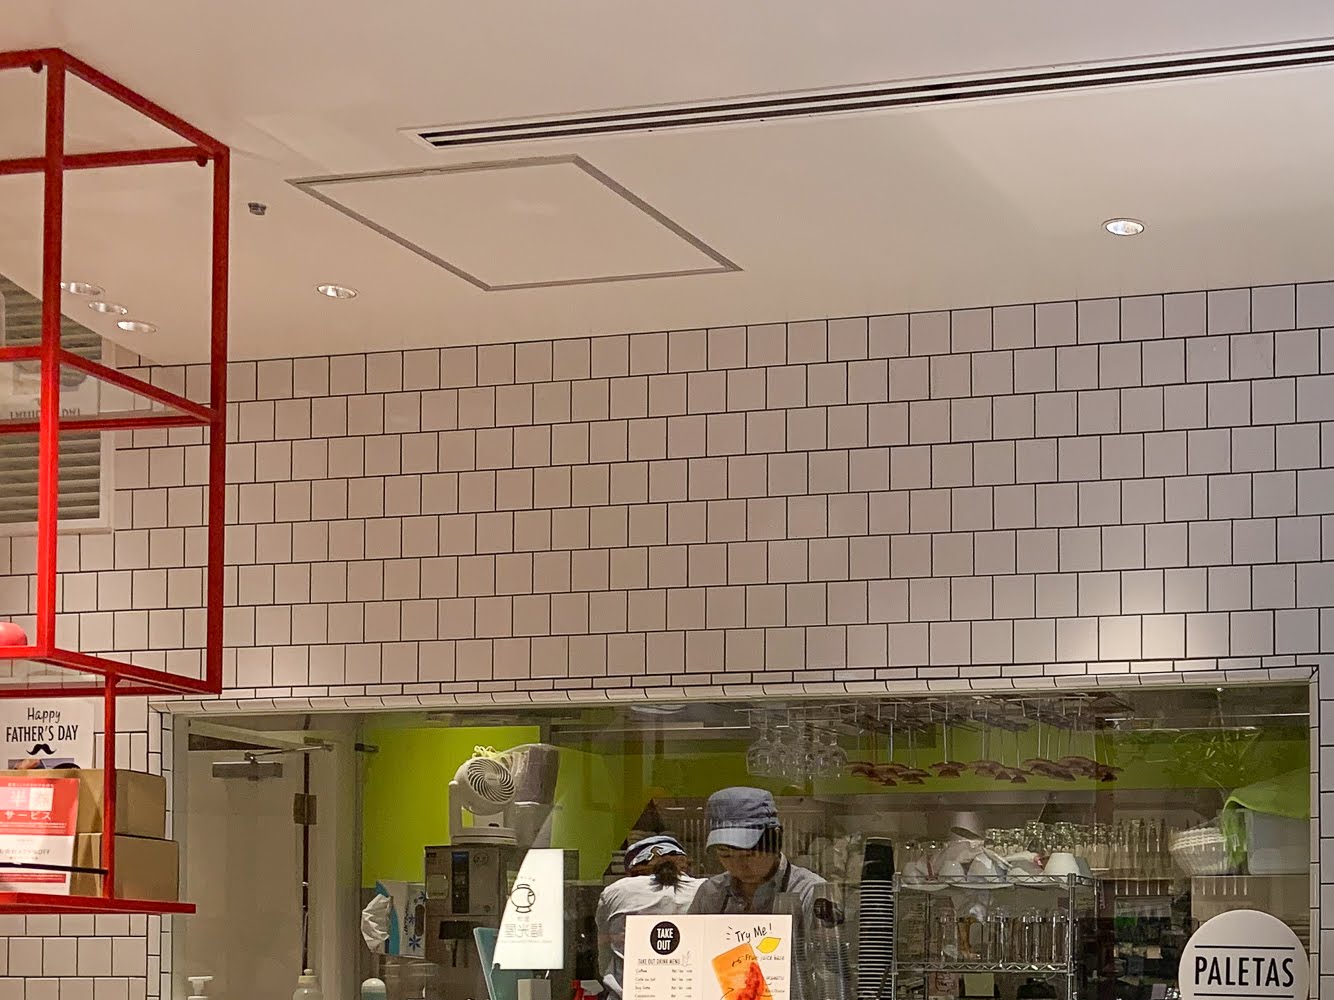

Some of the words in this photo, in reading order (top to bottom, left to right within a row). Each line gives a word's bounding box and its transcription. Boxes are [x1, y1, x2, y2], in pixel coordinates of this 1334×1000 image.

[27, 707, 61, 723] Happy
[6, 726, 54, 743] FATHER'S
[57, 725, 79, 741] DAY
[656, 928, 674, 939] TAKE
[735, 930, 751, 943] Try
[656, 940, 672, 951] OUT
[1194, 955, 1294, 988] PALETAS
